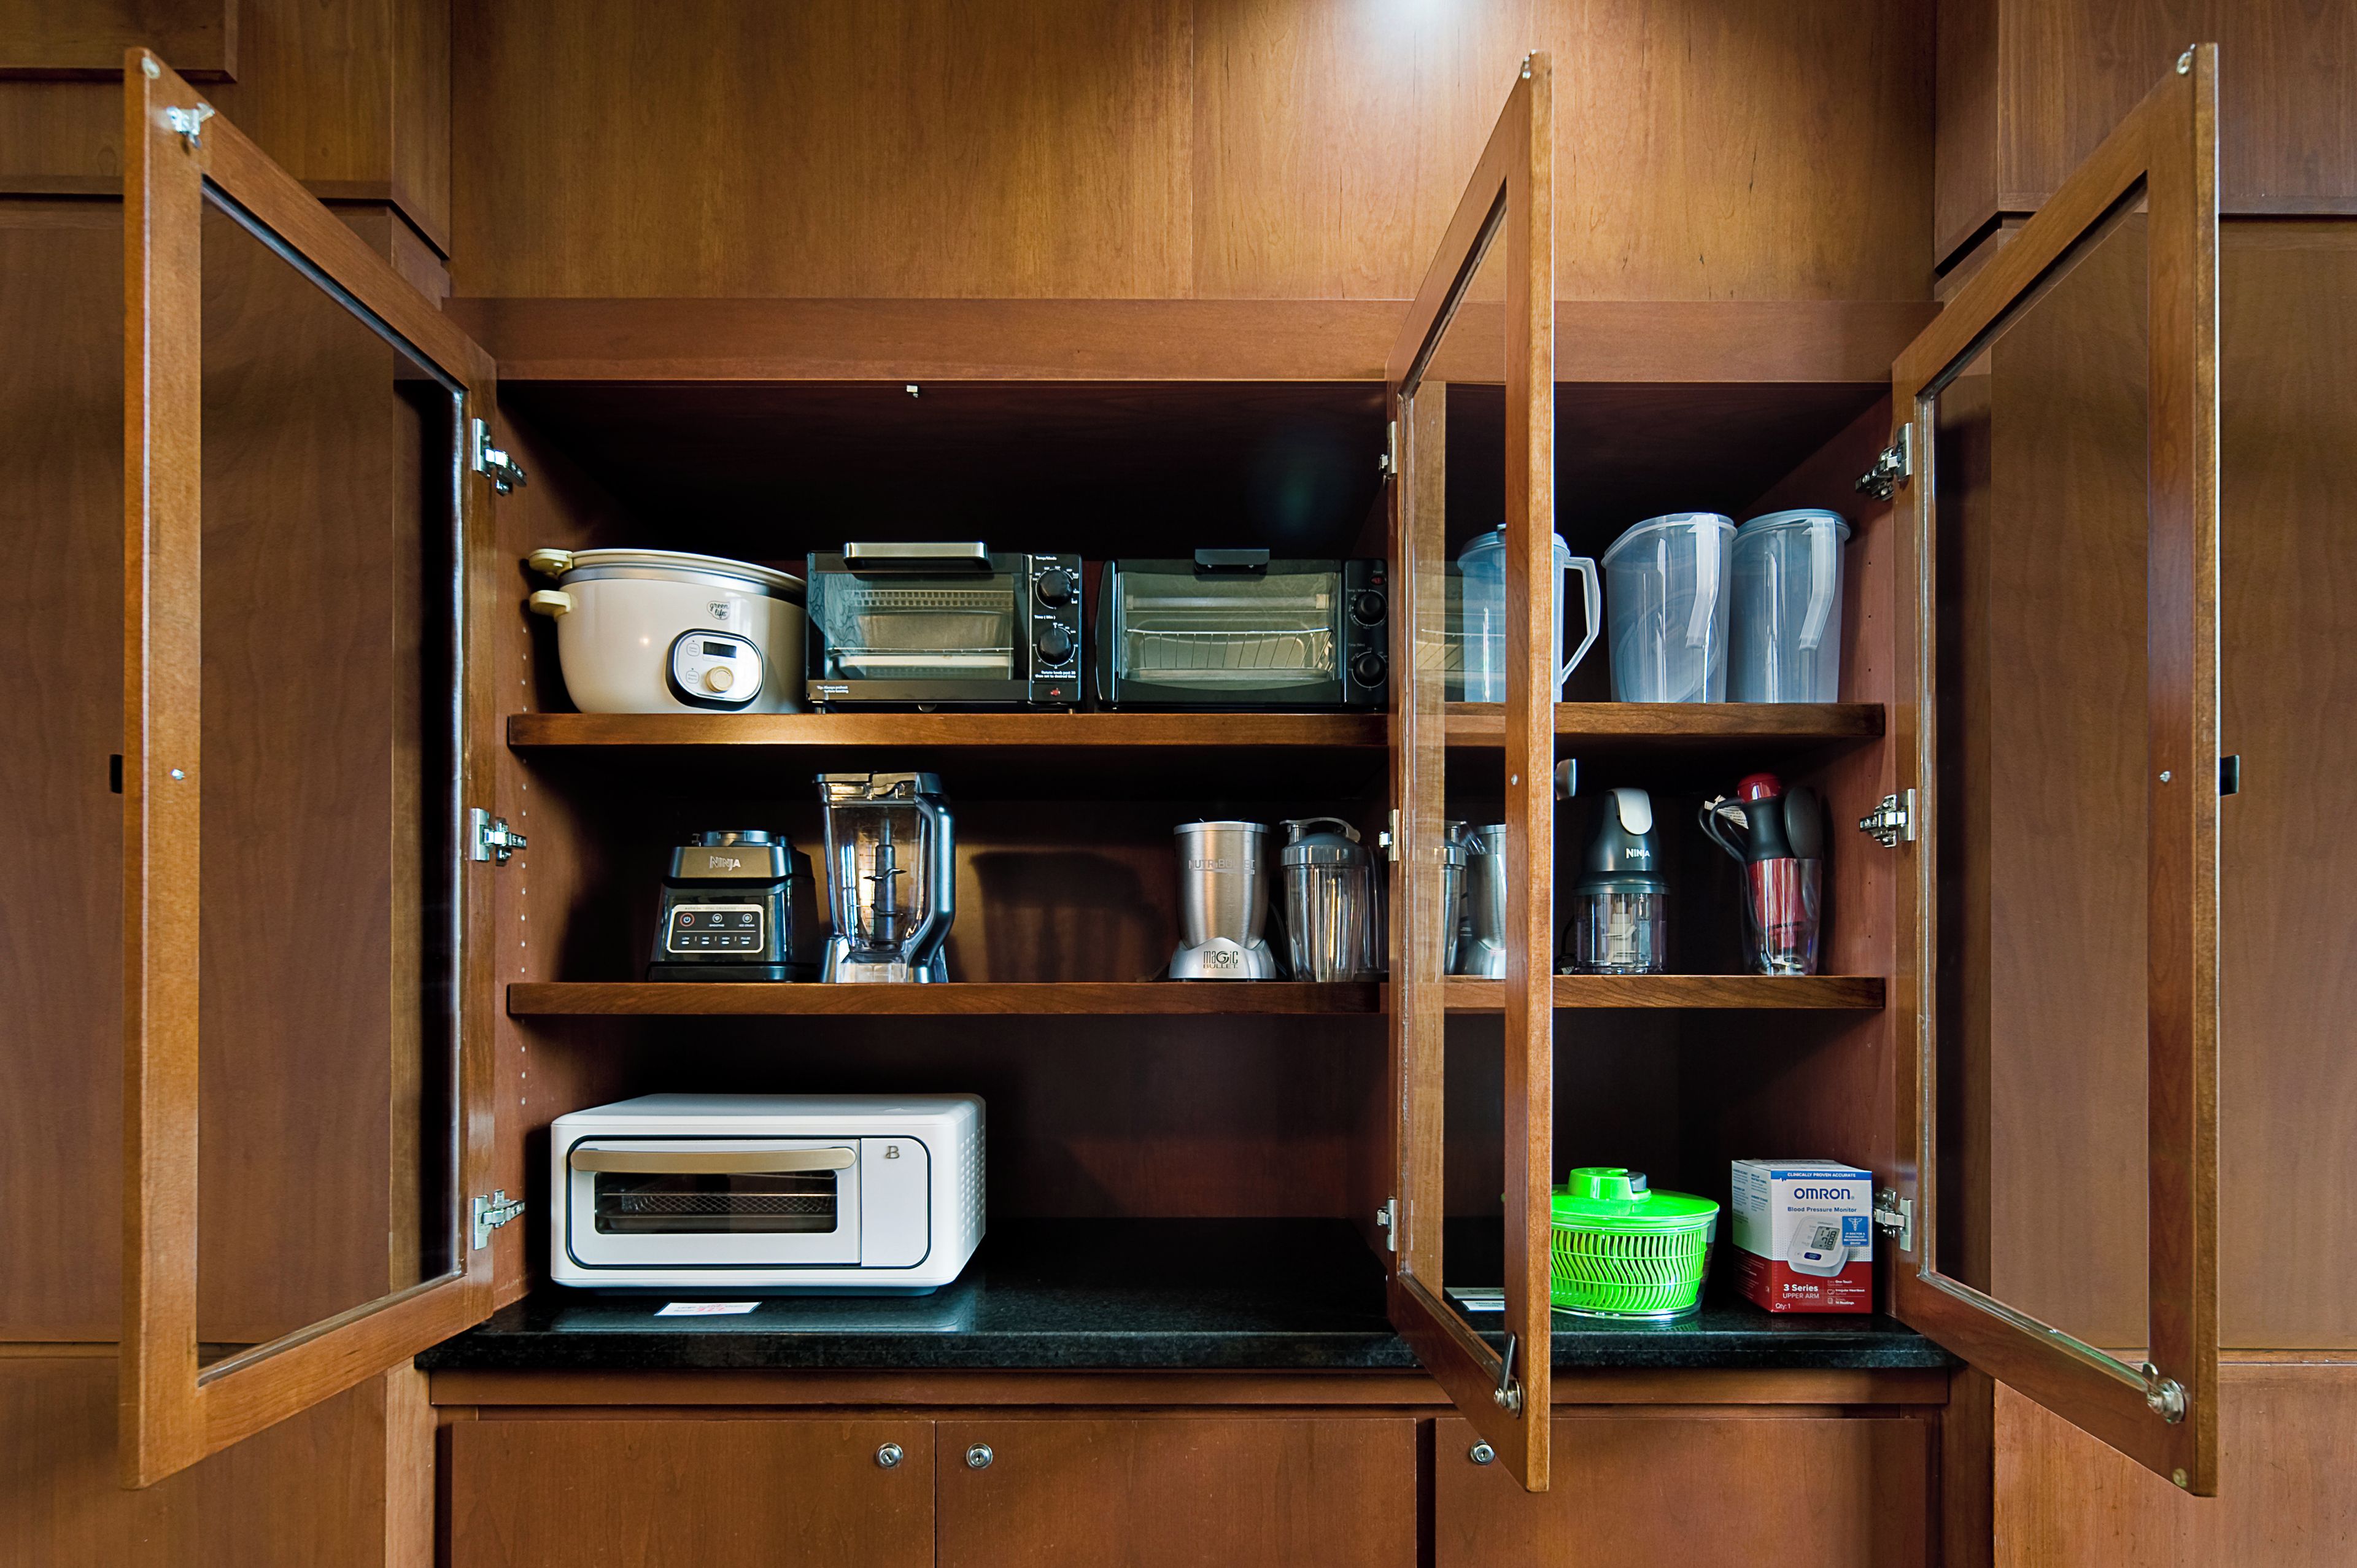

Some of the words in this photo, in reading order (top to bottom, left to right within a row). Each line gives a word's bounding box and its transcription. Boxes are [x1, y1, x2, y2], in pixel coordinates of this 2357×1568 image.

[710, 603, 729, 612] green
[1626, 848, 1650, 859] NINJA
[710, 855, 741, 871] NINJA
[1794, 1188, 1851, 1199] OMRON
[1821, 1230, 1837, 1238] 118
[1821, 1237, 1835, 1246] 78
